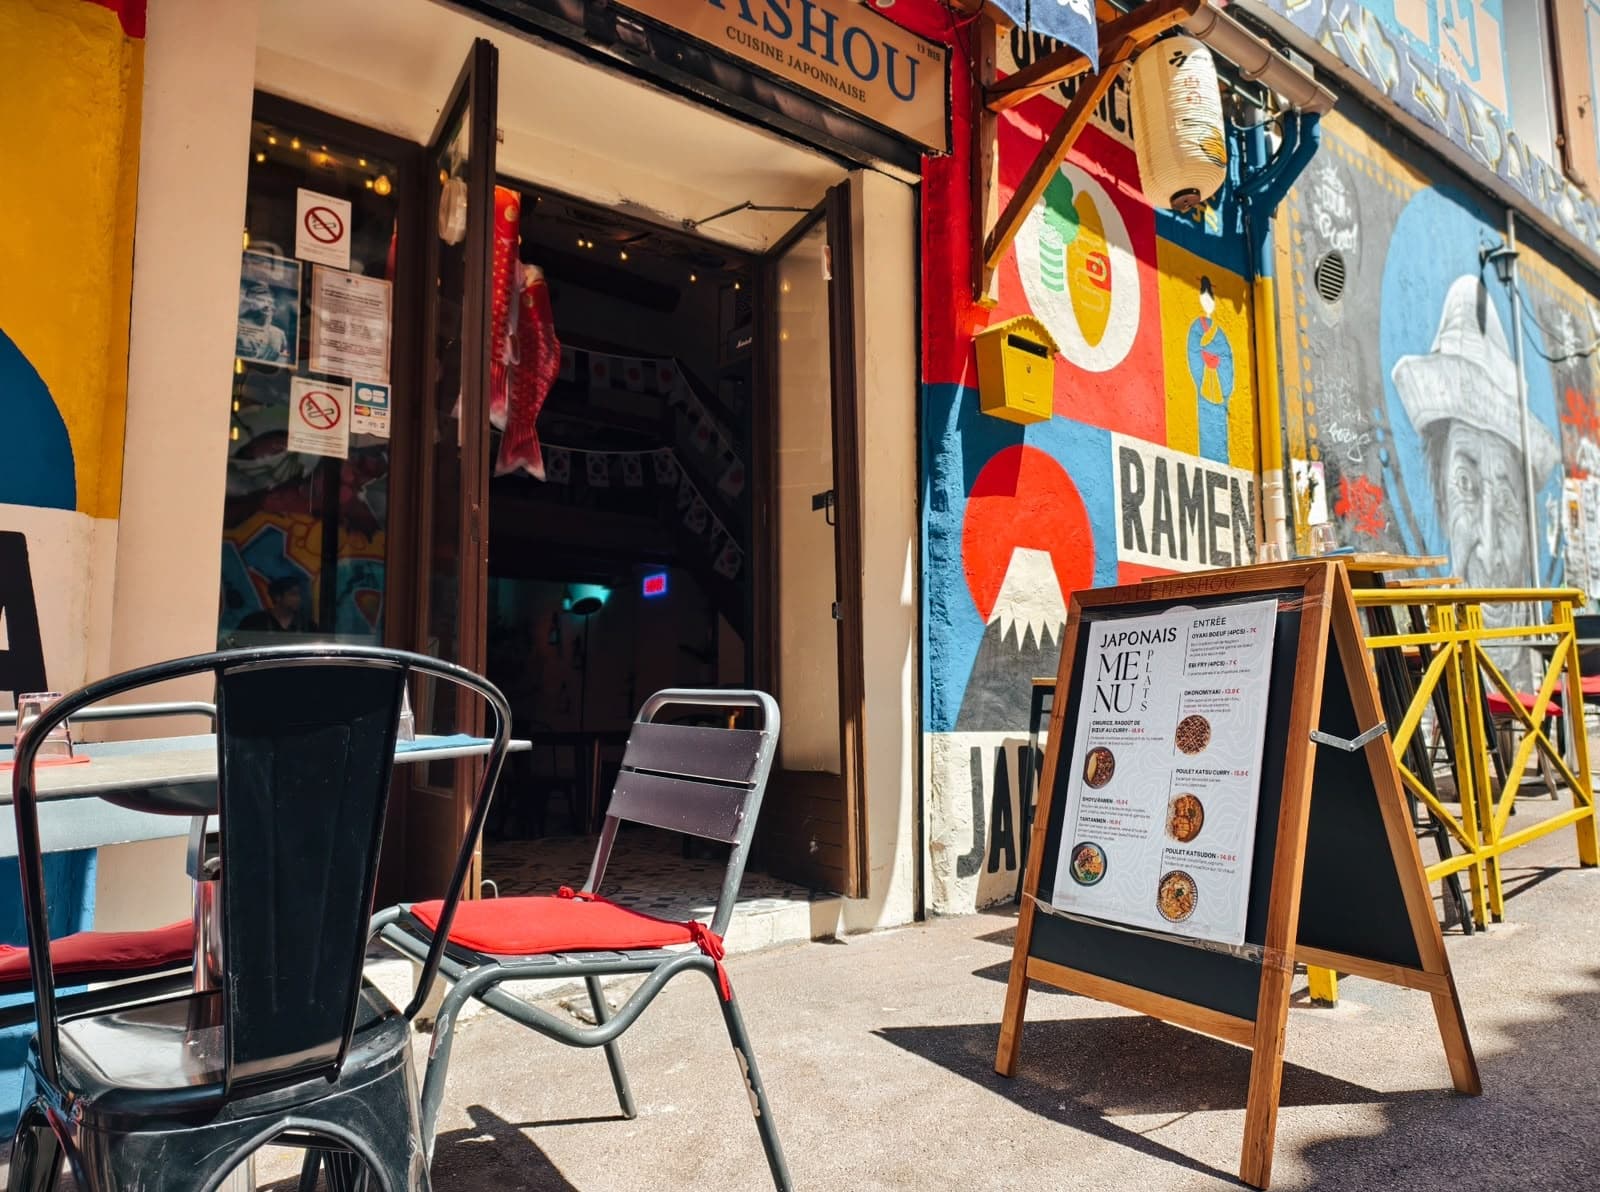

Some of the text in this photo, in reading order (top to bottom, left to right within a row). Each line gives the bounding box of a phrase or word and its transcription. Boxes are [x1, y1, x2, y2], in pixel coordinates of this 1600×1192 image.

[726, 25, 866, 103] CUISINE JAPONNAISE
[927, 48, 942, 62] BIS
[1119, 446, 1257, 567] RAMEN
[1193, 616, 1227, 628] ENTRÉE
[1100, 627, 1177, 648] JAPONAIS
[1097, 651, 1140, 681] ME
[1093, 683, 1135, 713] NU
[1165, 847, 1186, 855] POULET
[1186, 850, 1217, 859] KATSUDON
